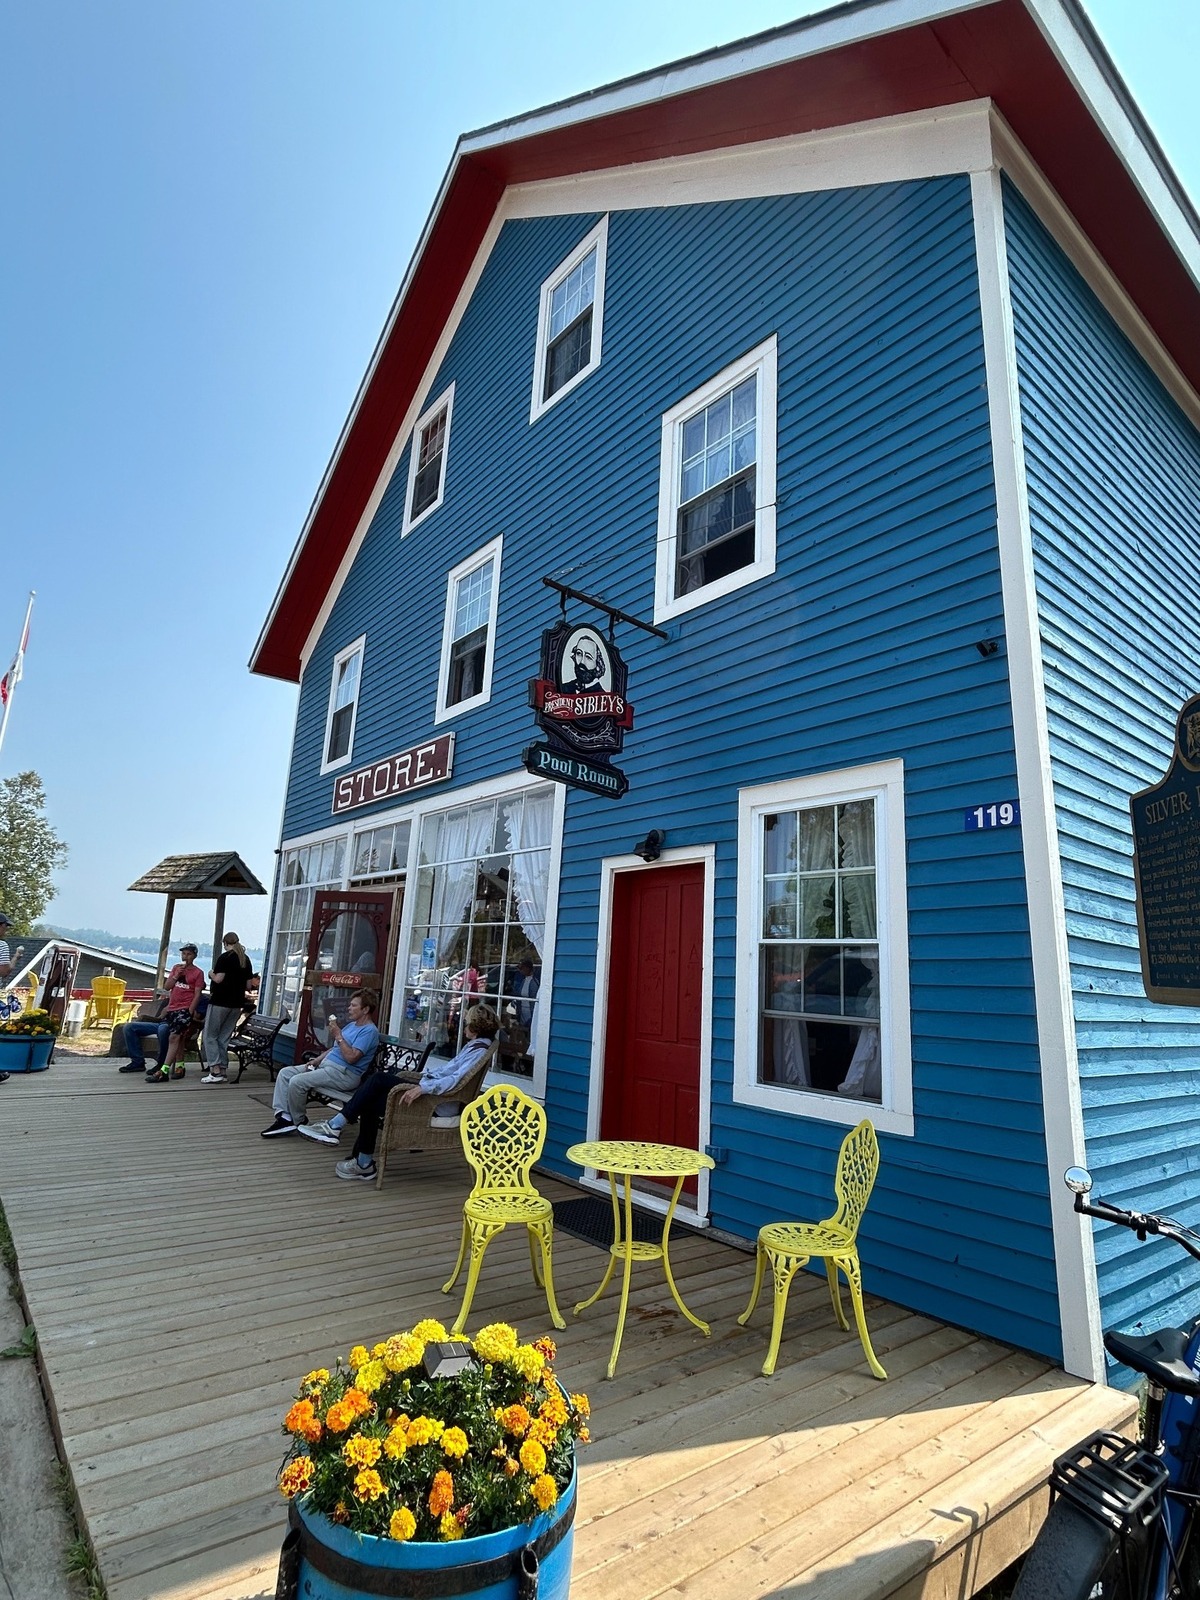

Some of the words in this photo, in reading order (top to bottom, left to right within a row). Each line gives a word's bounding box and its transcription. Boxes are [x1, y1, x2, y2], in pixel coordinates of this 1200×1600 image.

[543, 697, 574, 714] PRESIDENT
[574, 694, 624, 716] SIBLEY'S
[538, 750, 573, 776] Pool
[576, 762, 618, 790] Room
[973, 803, 1014, 828] 119
[1145, 792, 1191, 824] SILVER
